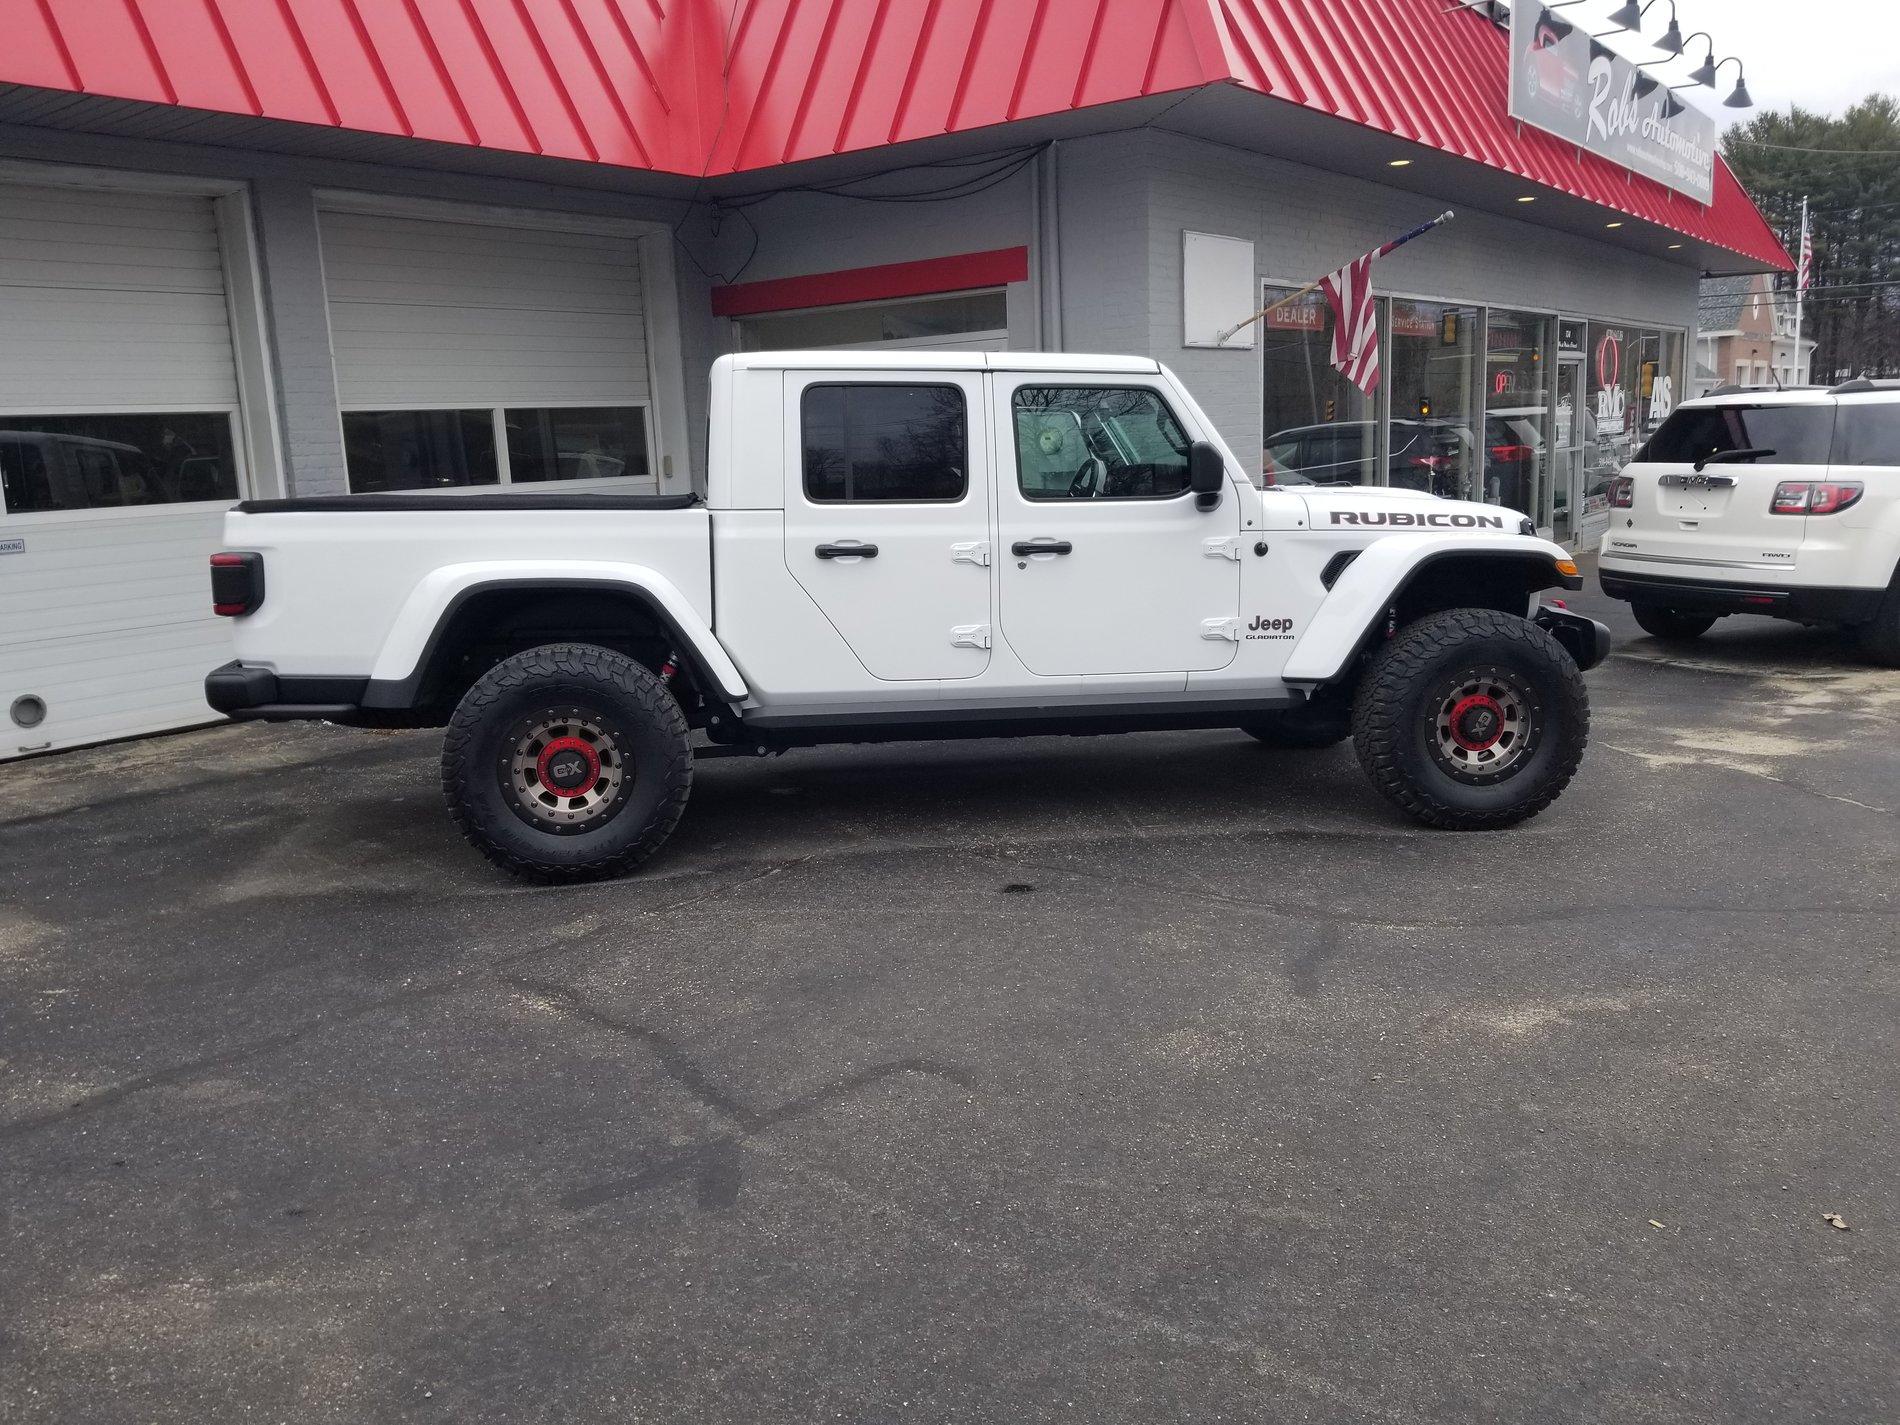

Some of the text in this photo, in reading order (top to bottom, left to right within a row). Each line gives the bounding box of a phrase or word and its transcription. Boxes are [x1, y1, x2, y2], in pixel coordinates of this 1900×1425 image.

[1641, 97, 1711, 172] Automotive
[1276, 306, 1316, 325] DEALER
[1495, 373, 1516, 395] OPEN
[1329, 510, 1504, 529] RUBICON
[0, 542, 22, 551] ARKING
[1247, 615, 1294, 634] Jeep
